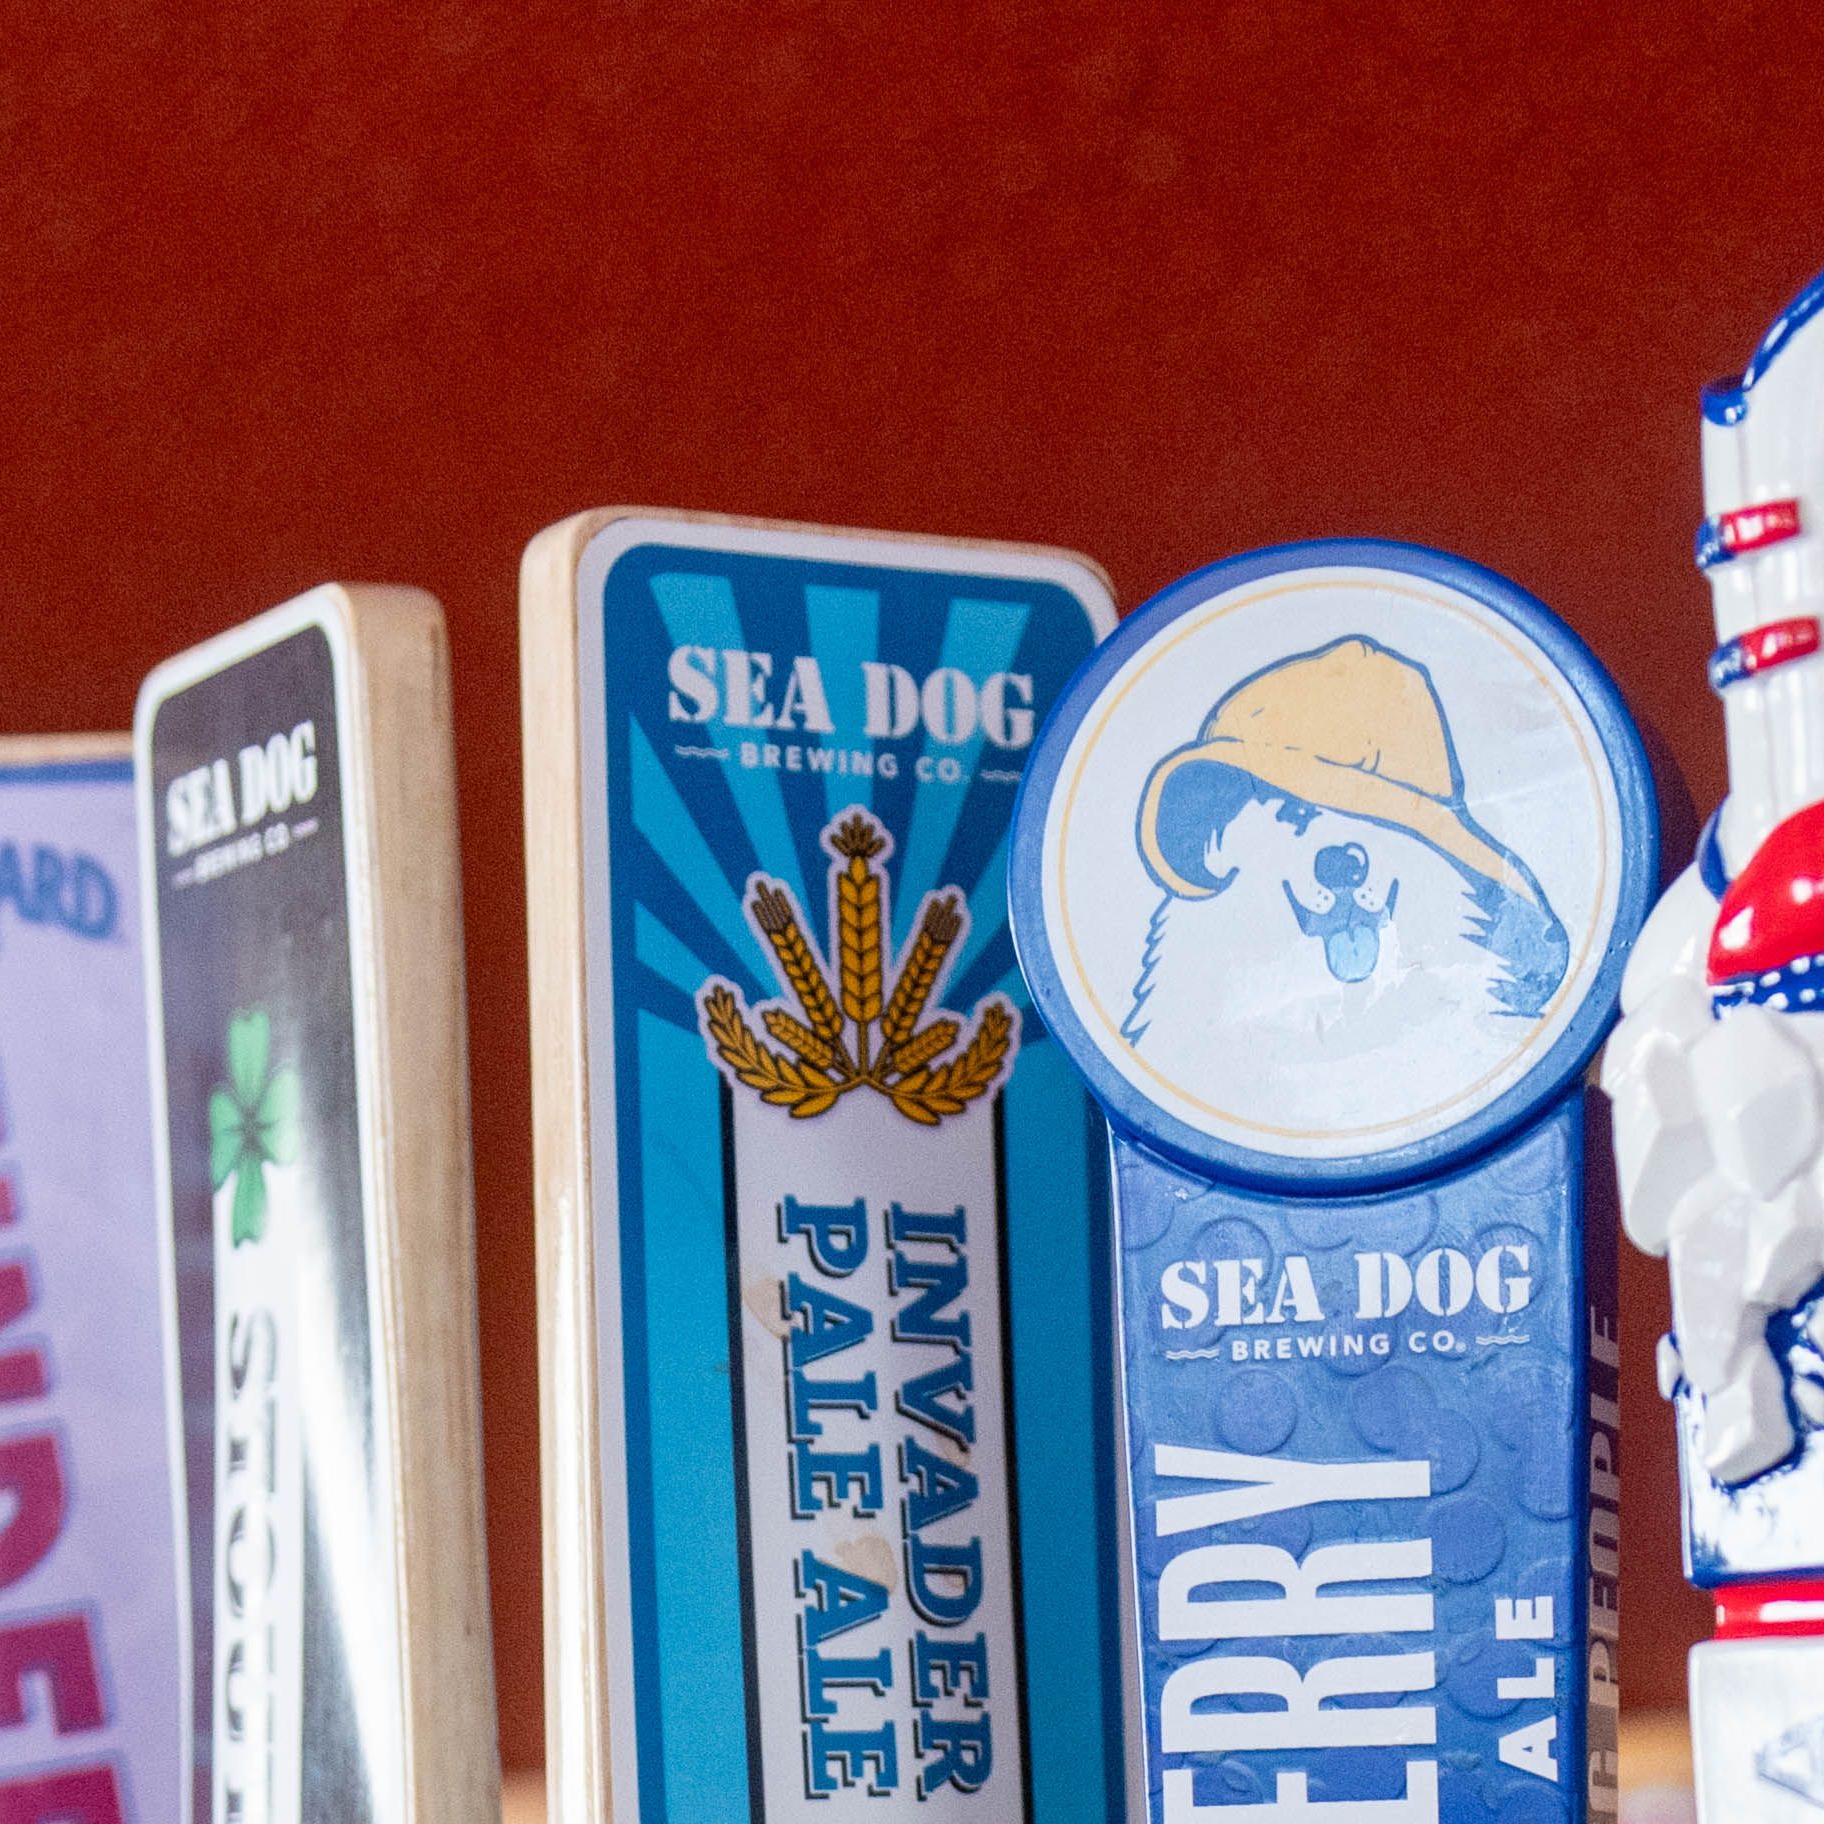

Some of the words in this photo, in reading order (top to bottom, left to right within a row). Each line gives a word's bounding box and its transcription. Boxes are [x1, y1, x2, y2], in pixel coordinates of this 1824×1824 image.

[667, 645, 835, 734] SEA
[863, 661, 1035, 749] DOG
[740, 743, 899, 781] BREWING
[166, 757, 238, 858] SEA
[238, 719, 319, 827] DOG
[1159, 1253, 1325, 1331] SEA
[1353, 1245, 1533, 1320] DOG
[1232, 1332, 1391, 1362] BREWING
[776, 1194, 887, 1523] PALE
[883, 1202, 994, 1802] INVADER
[793, 1548, 900, 1802] ALE
[1495, 1595, 1561, 1782] ALE
